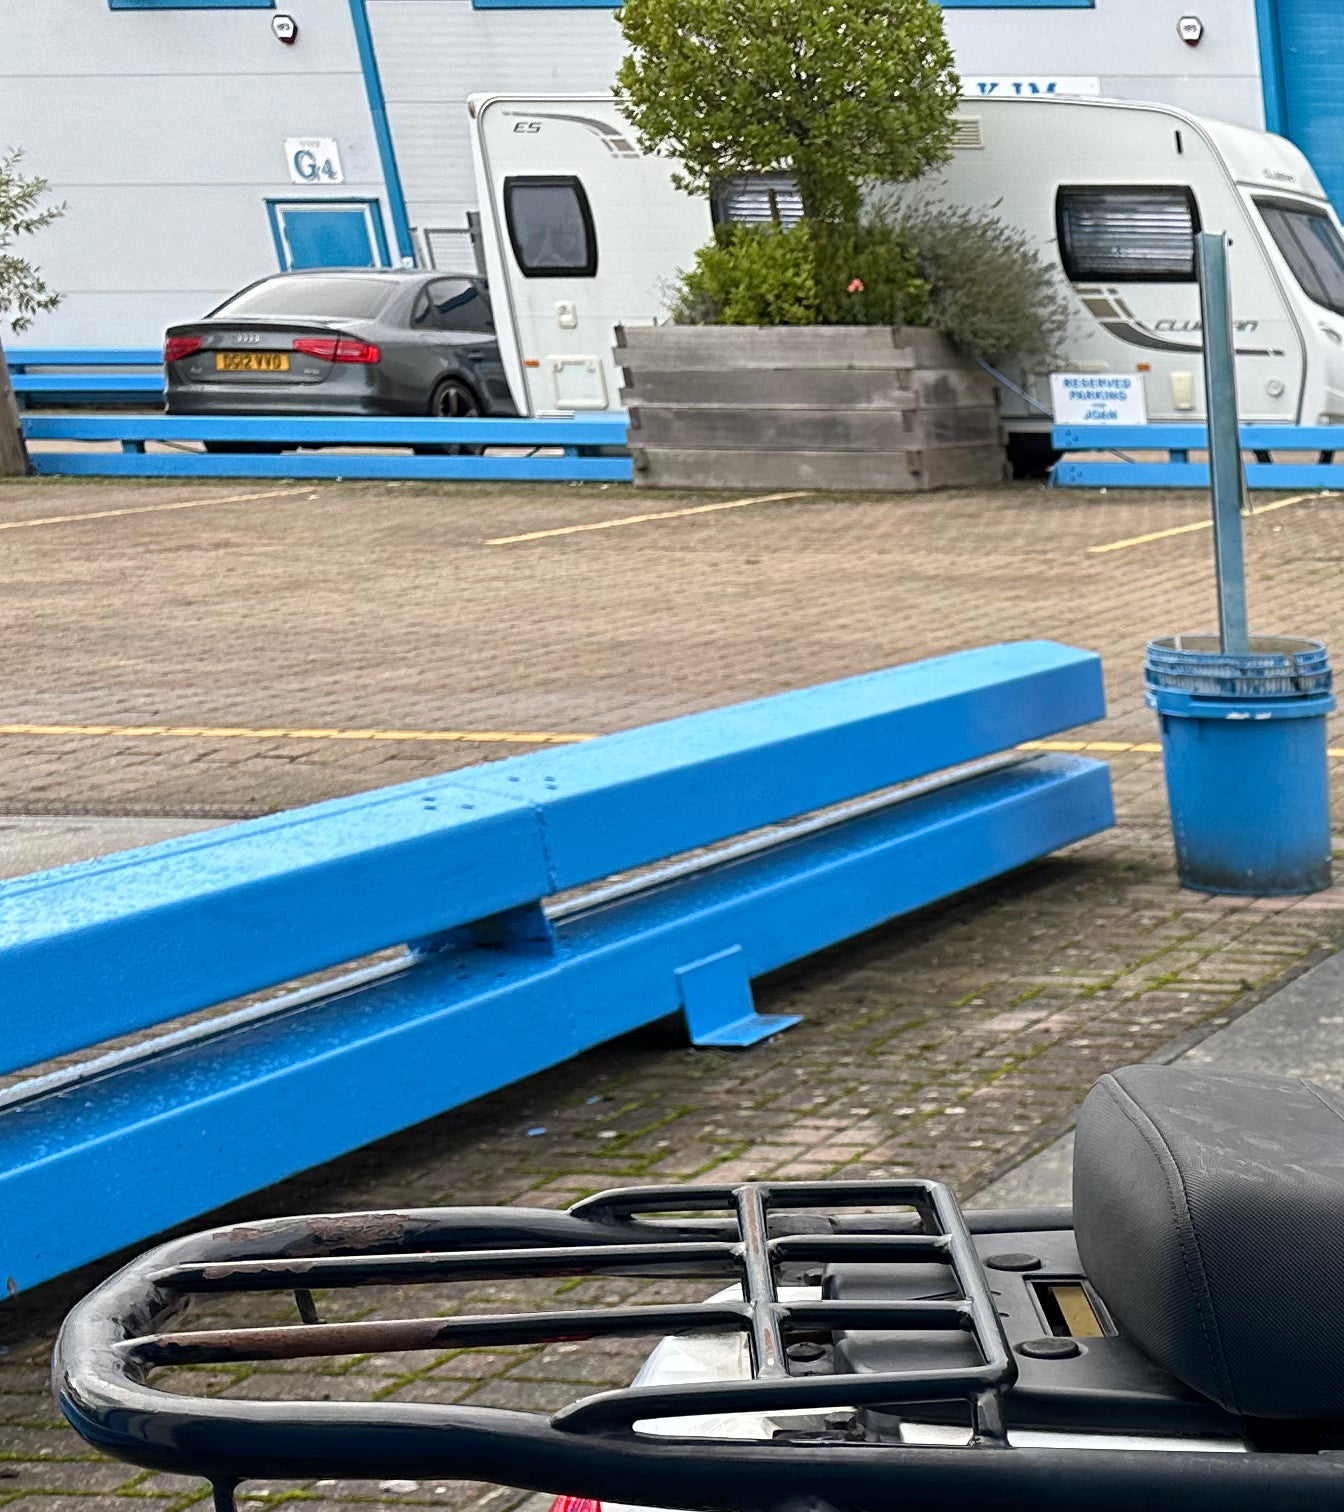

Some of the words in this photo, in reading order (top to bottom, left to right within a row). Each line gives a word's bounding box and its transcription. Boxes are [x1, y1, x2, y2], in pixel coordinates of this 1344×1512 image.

[512, 121, 543, 134] ES
[293, 149, 336, 181] G4
[1062, 377, 1132, 390] RESERVED
[1068, 389, 1127, 402] PARKING
